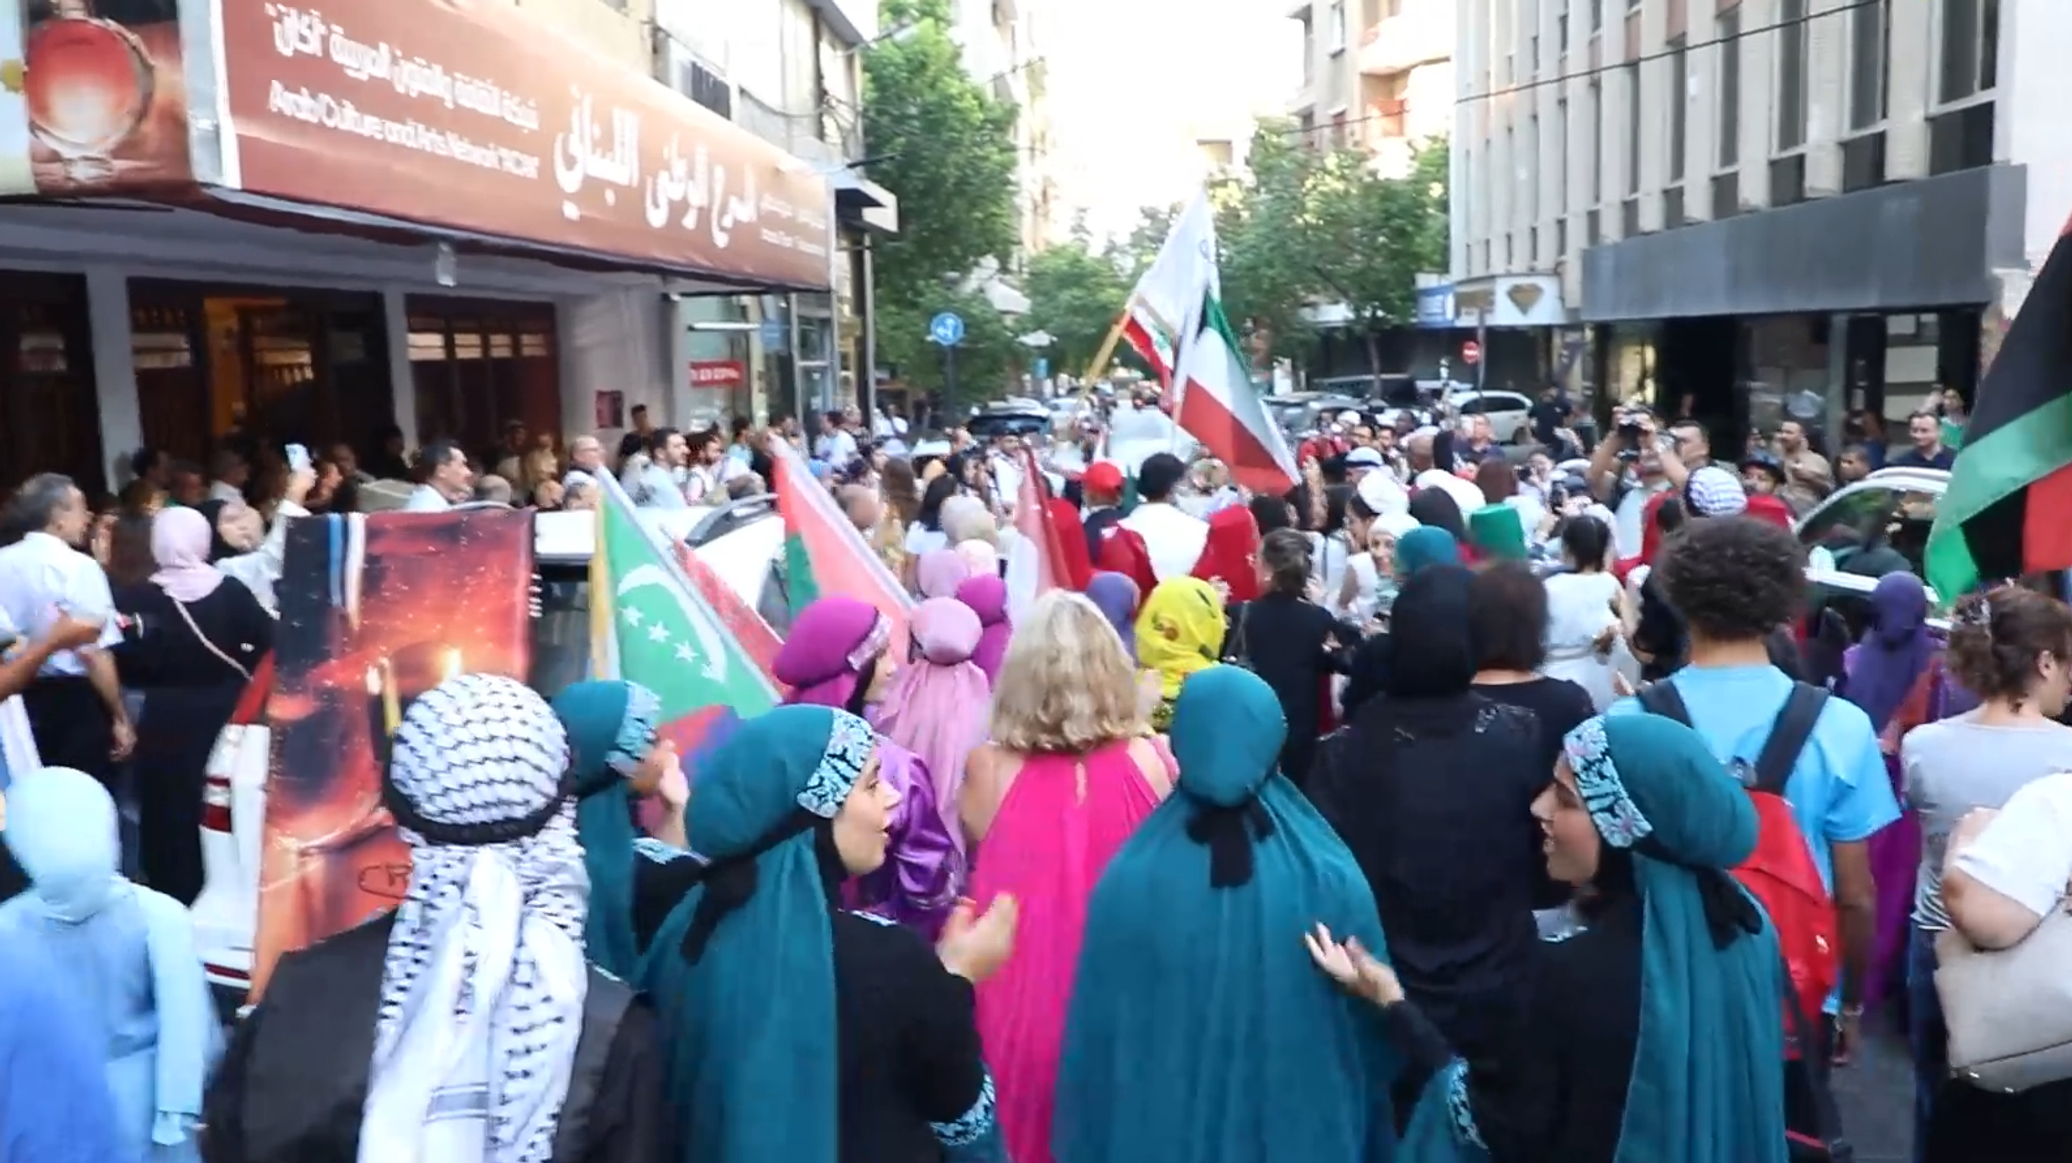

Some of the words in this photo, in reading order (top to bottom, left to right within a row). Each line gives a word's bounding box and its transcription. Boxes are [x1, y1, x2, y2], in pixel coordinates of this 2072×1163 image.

[269, 79, 319, 123] Arab
[317, 92, 384, 140] Culture
[382, 118, 416, 148] and
[414, 123, 446, 154] Arts
